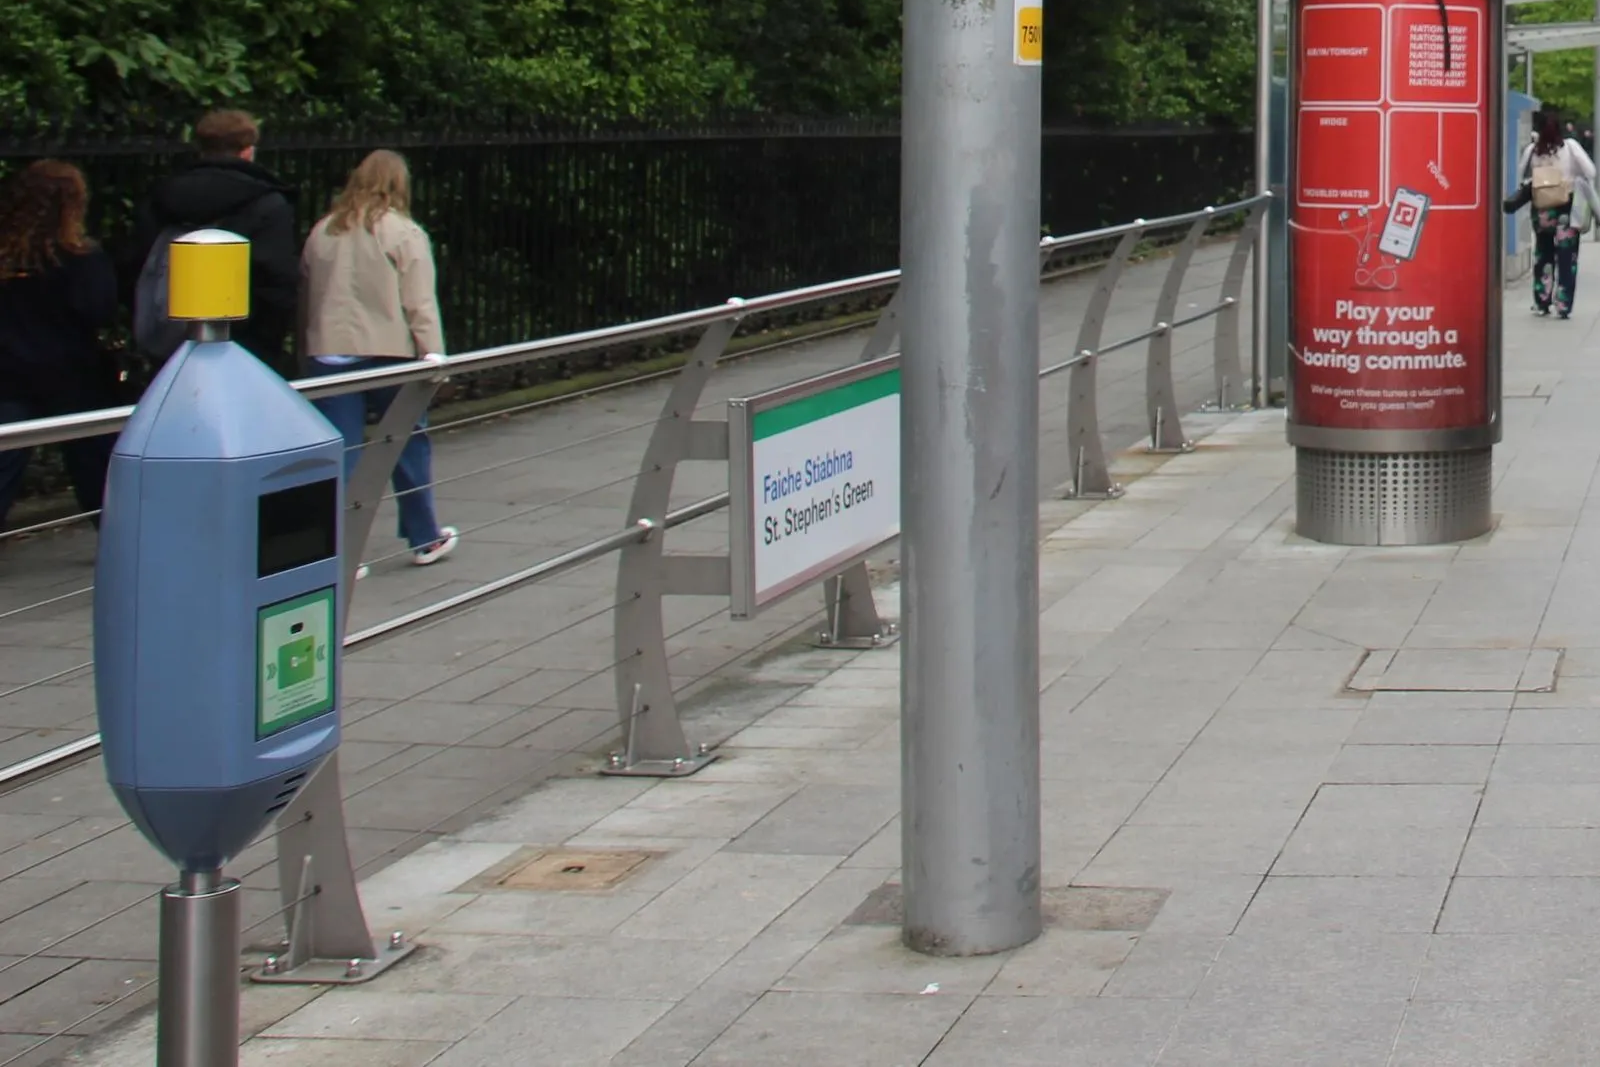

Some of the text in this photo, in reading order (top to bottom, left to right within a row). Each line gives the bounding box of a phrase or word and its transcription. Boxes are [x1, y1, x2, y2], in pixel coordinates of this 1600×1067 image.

[1336, 300, 1434, 325] Play your
[1312, 325, 1458, 350] way through a
[1304, 346, 1467, 373] boring commute.
[1333, 386, 1355, 397] given
[1356, 387, 1381, 397] these
[1382, 388, 1408, 398] tunes
[1340, 399, 1359, 409] Can
[1359, 401, 1377, 412] you
[1377, 401, 1405, 412] guess
[763, 448, 853, 504] Faiche Stiabhna
[764, 479, 874, 546] St. Stephen's Green
